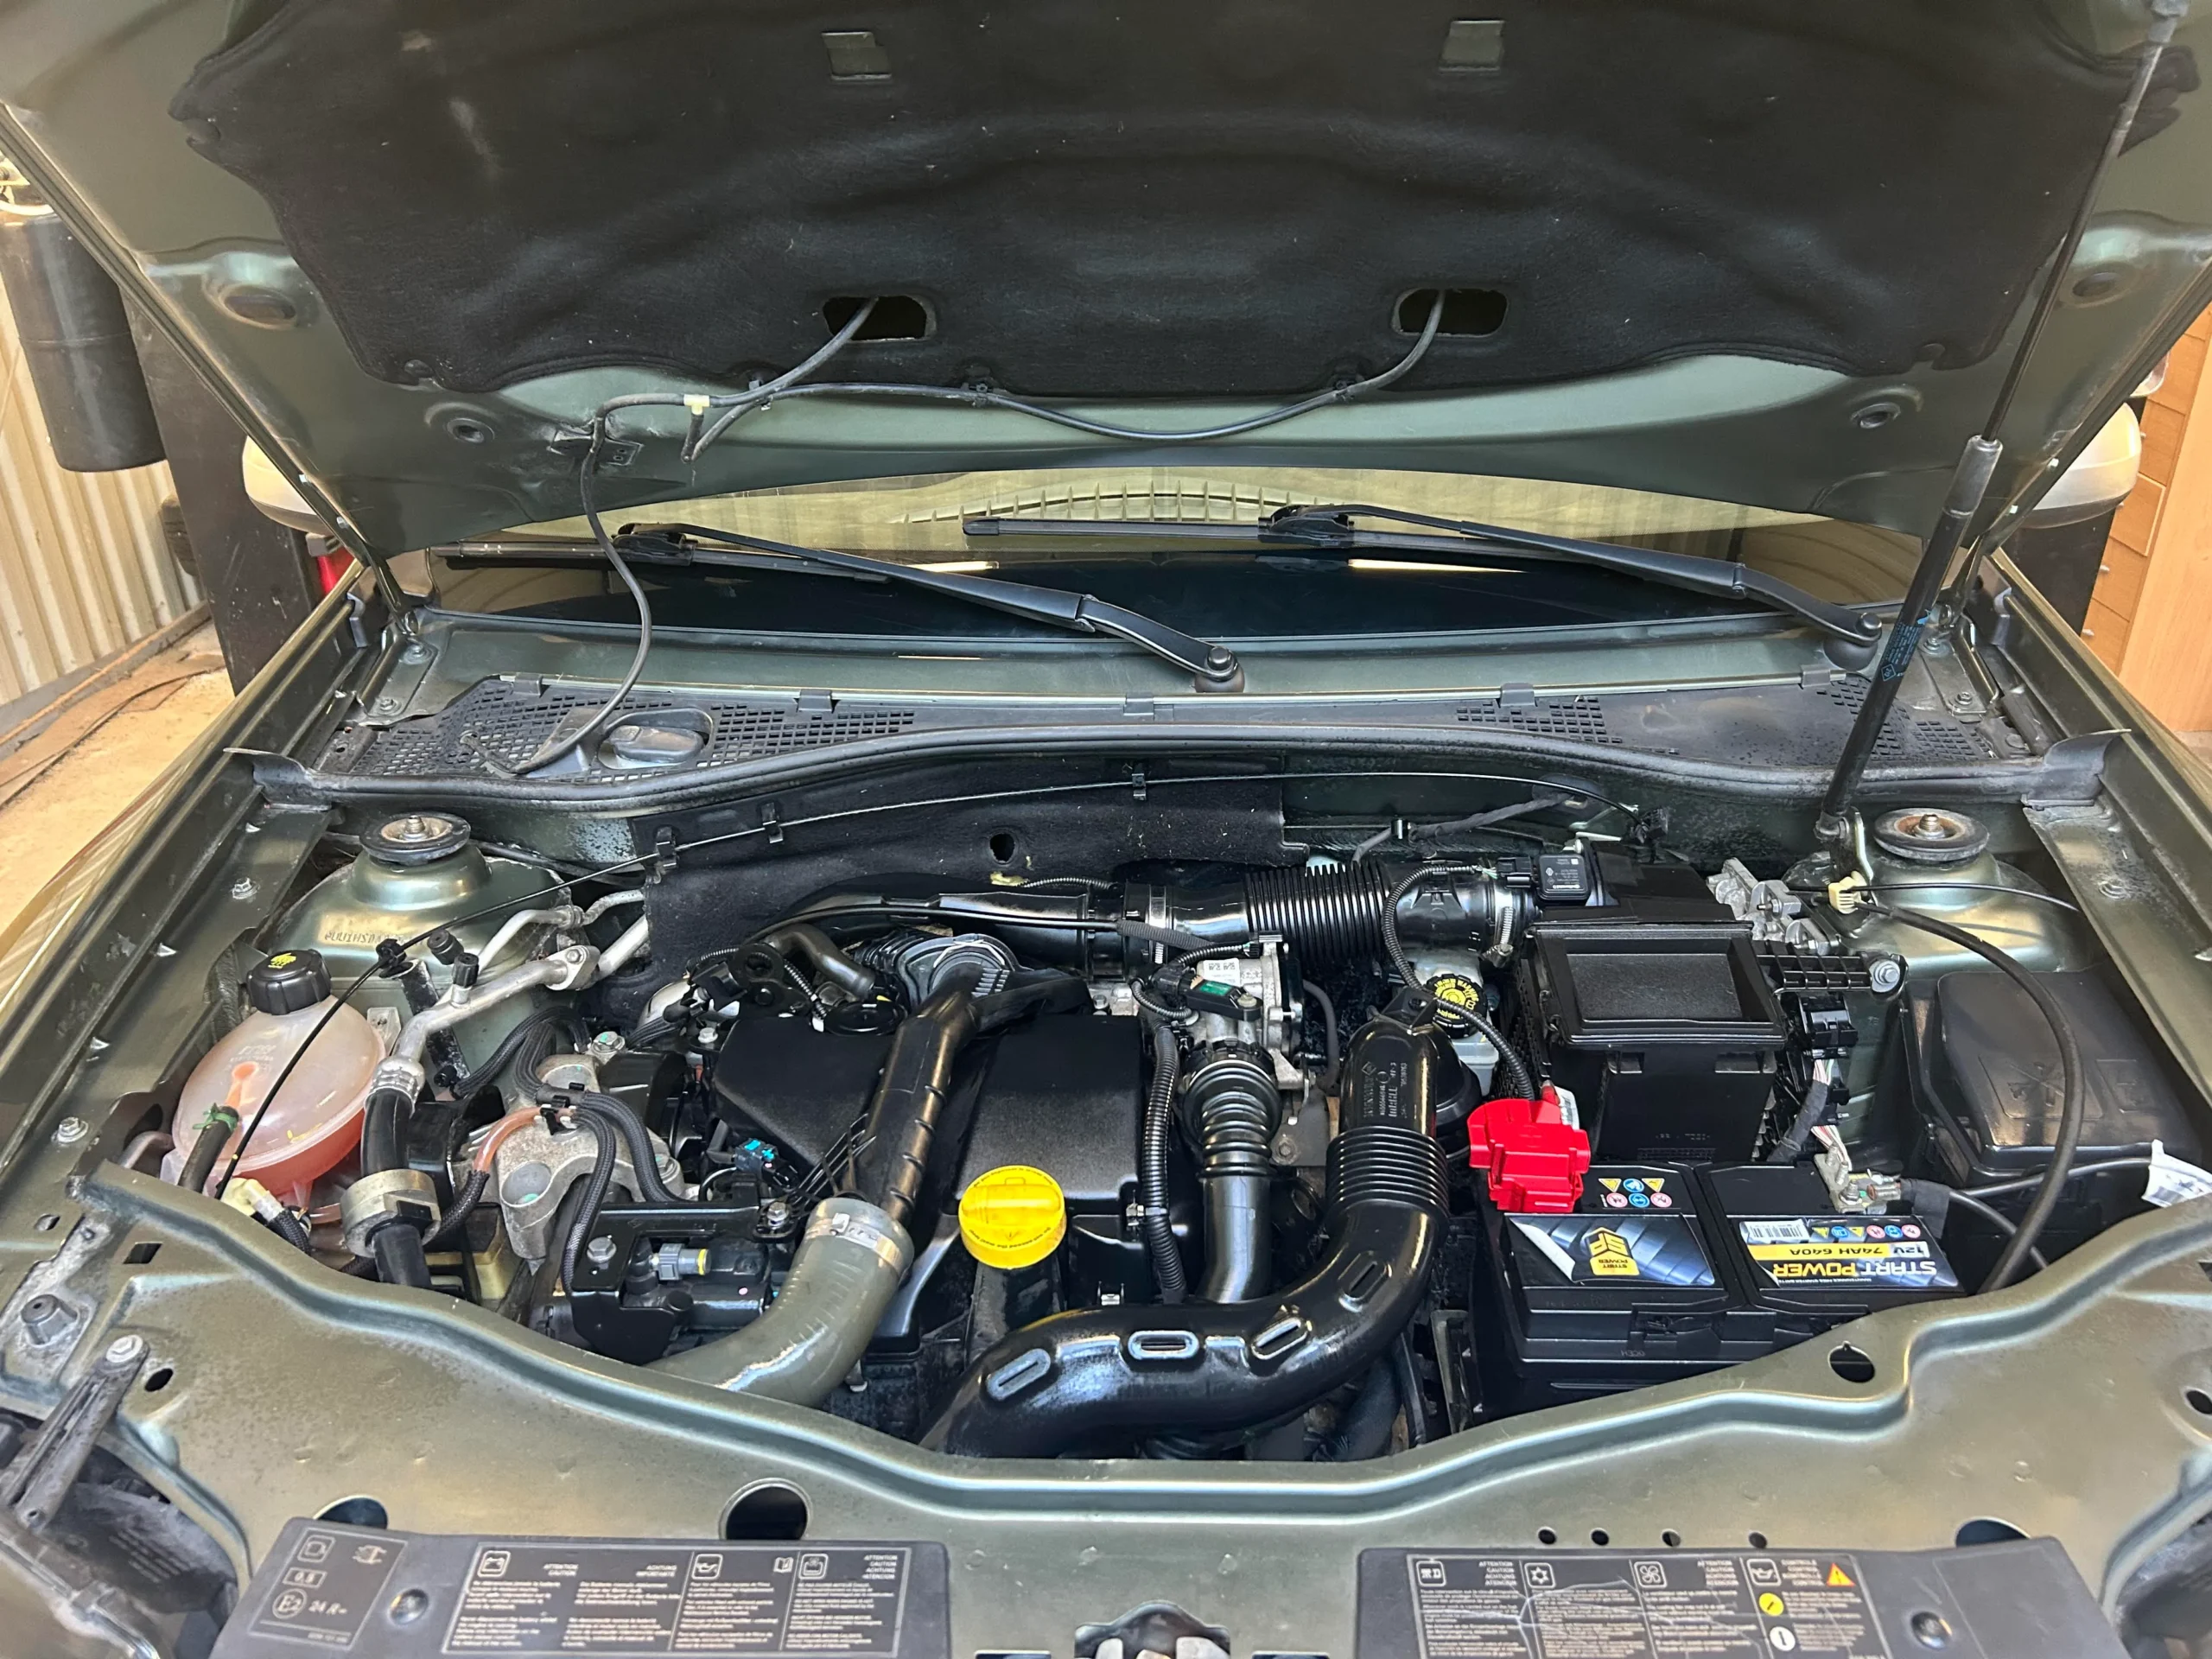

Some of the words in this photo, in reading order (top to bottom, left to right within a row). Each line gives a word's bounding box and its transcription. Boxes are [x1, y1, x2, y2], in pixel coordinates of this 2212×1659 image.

[1789, 1248, 1835, 1256] 640A
[1839, 1247, 1884, 1255] 74AH
[1893, 1245, 1924, 1254] 12V
[1773, 1262, 1856, 1277] POWER
[1860, 1261, 1937, 1276] START
